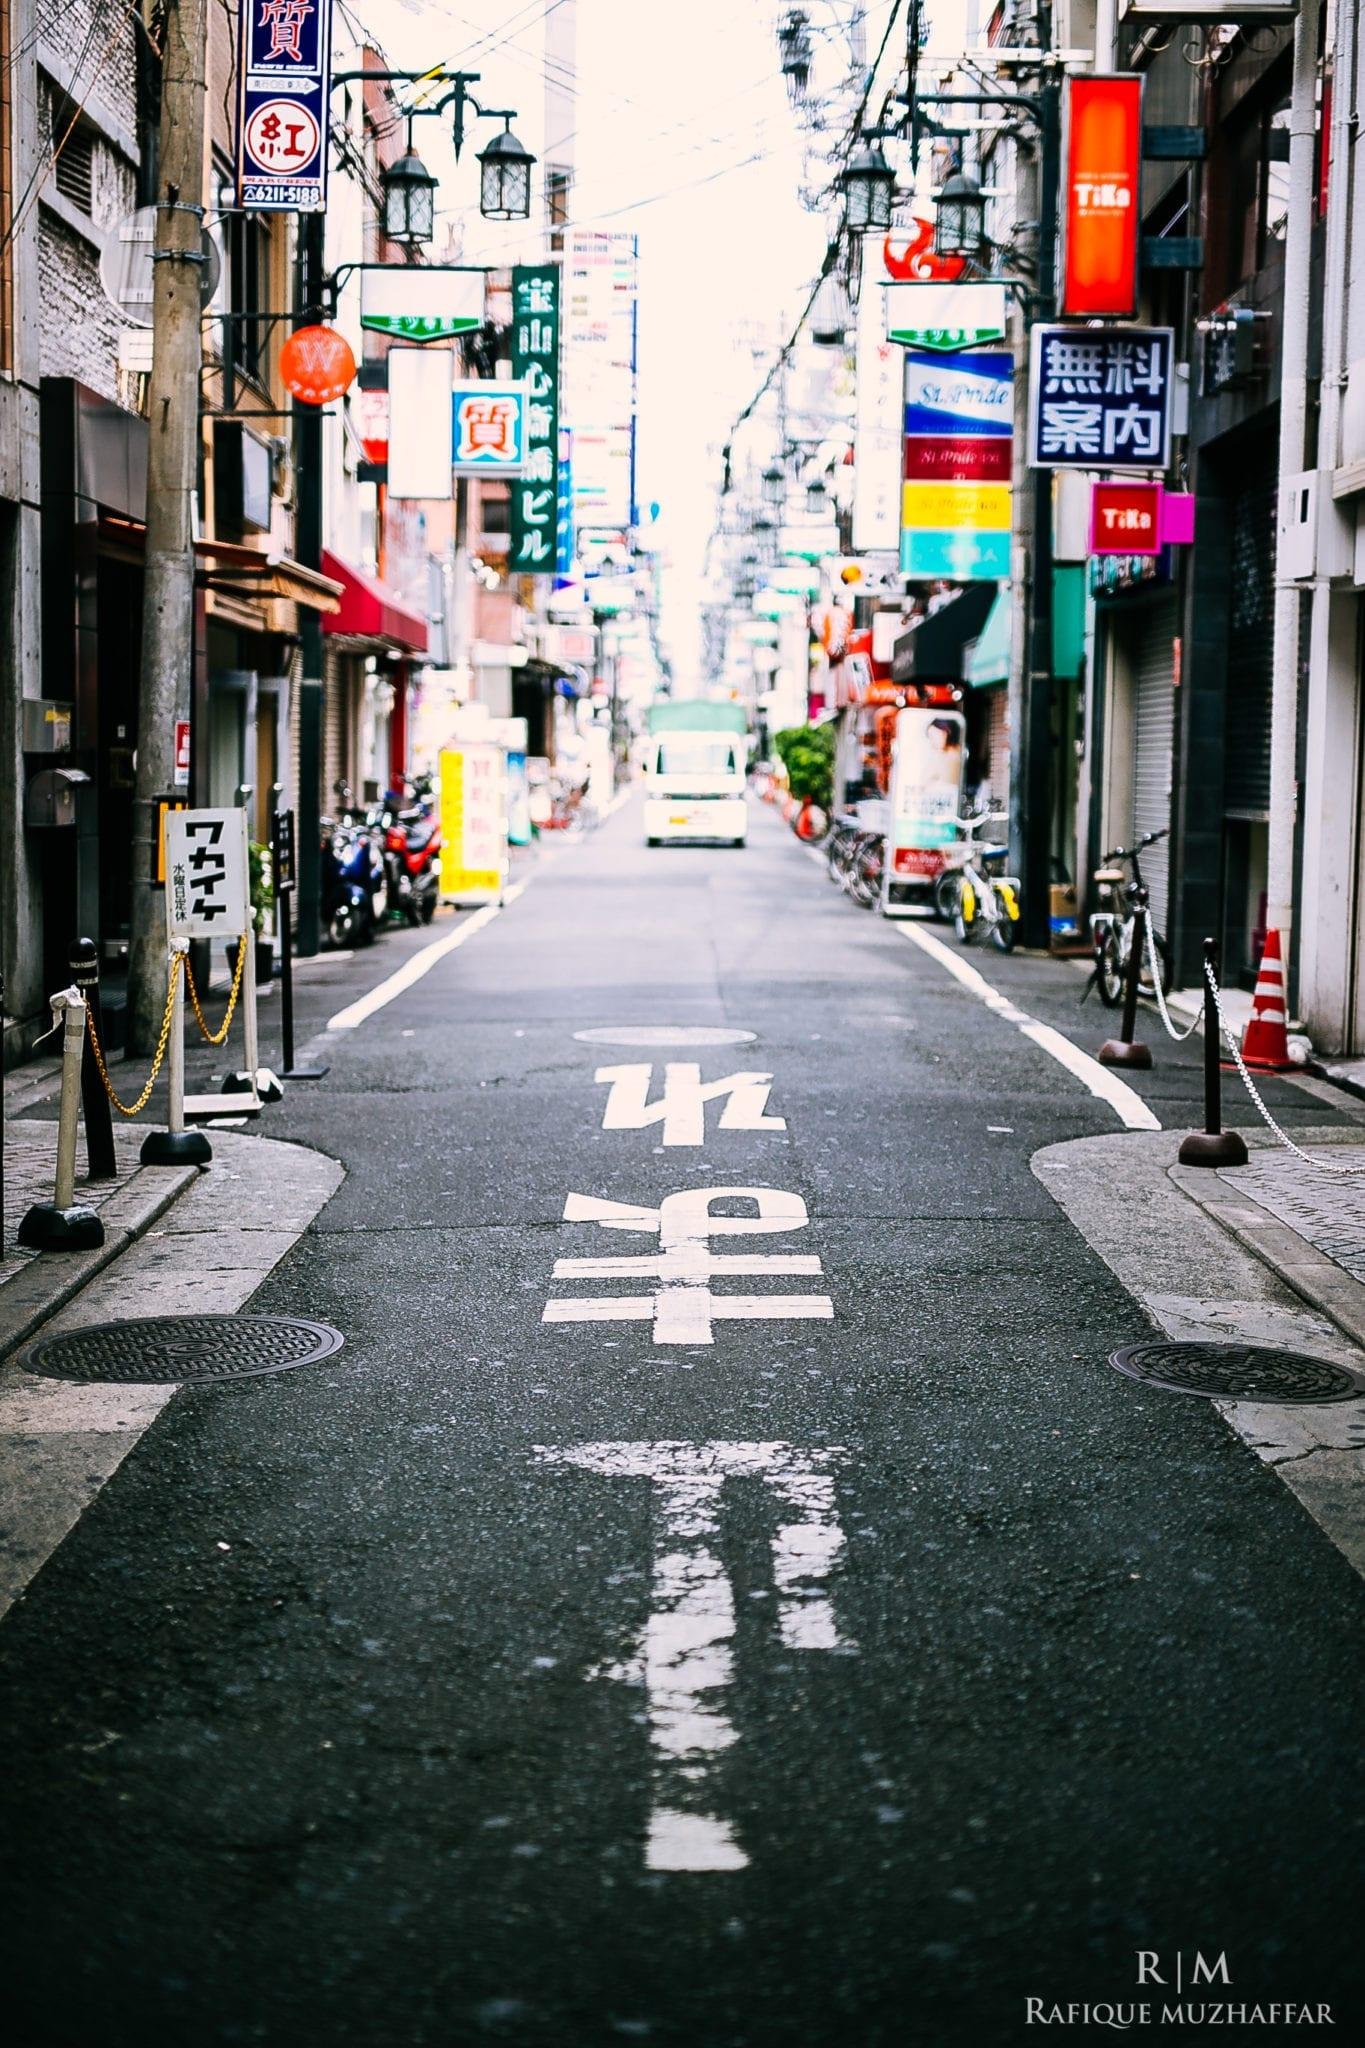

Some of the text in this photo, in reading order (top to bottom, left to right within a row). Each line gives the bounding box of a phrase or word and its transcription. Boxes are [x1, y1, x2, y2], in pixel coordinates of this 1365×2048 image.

[258, 0, 315, 62] 質
[259, 112, 306, 159] 紅
[1044, 340, 1164, 396] 無料
[464, 401, 512, 453] 質
[1042, 401, 1161, 456] 案内
[173, 863, 188, 922] 水曜日定休
[185, 821, 226, 921] ワカイケ
